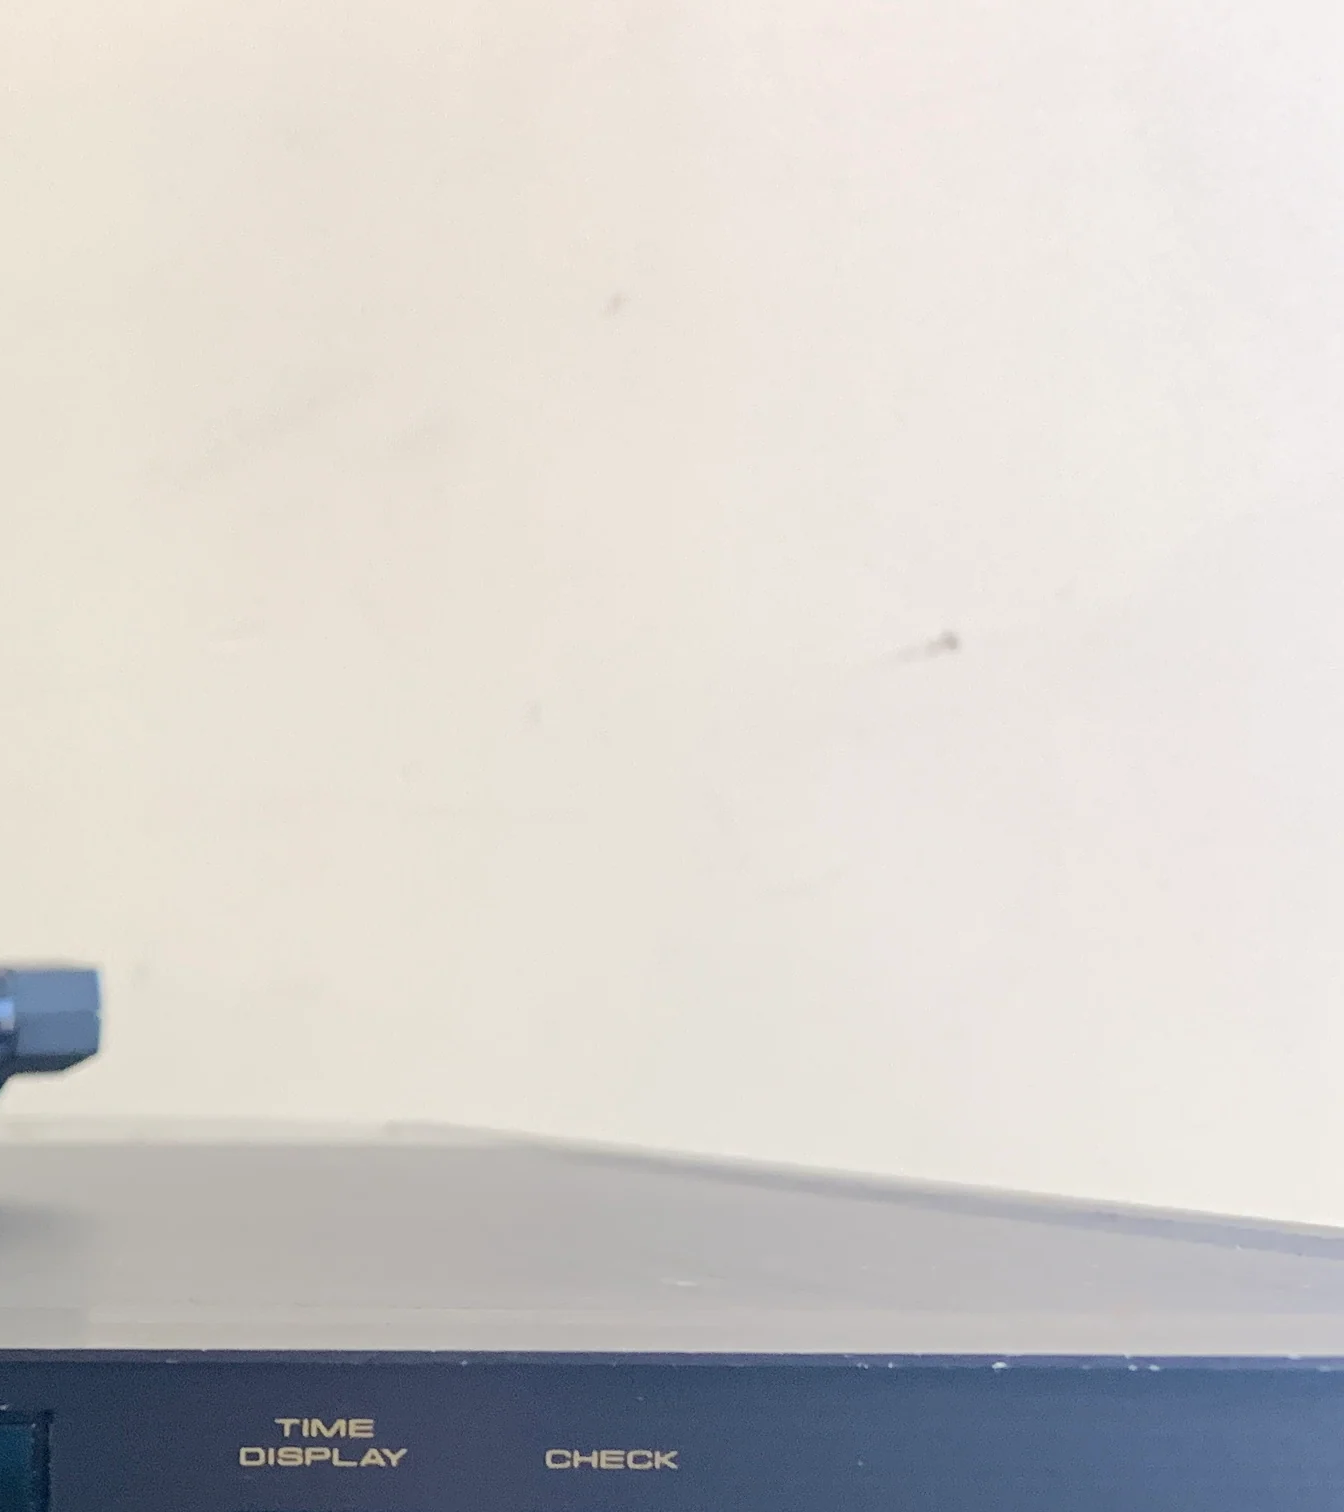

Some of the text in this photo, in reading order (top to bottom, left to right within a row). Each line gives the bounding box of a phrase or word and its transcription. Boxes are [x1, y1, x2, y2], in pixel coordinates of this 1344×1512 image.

[275, 1418, 374, 1438] TIME
[239, 1446, 407, 1468] DISPLAY
[545, 1450, 678, 1470] CHECK
